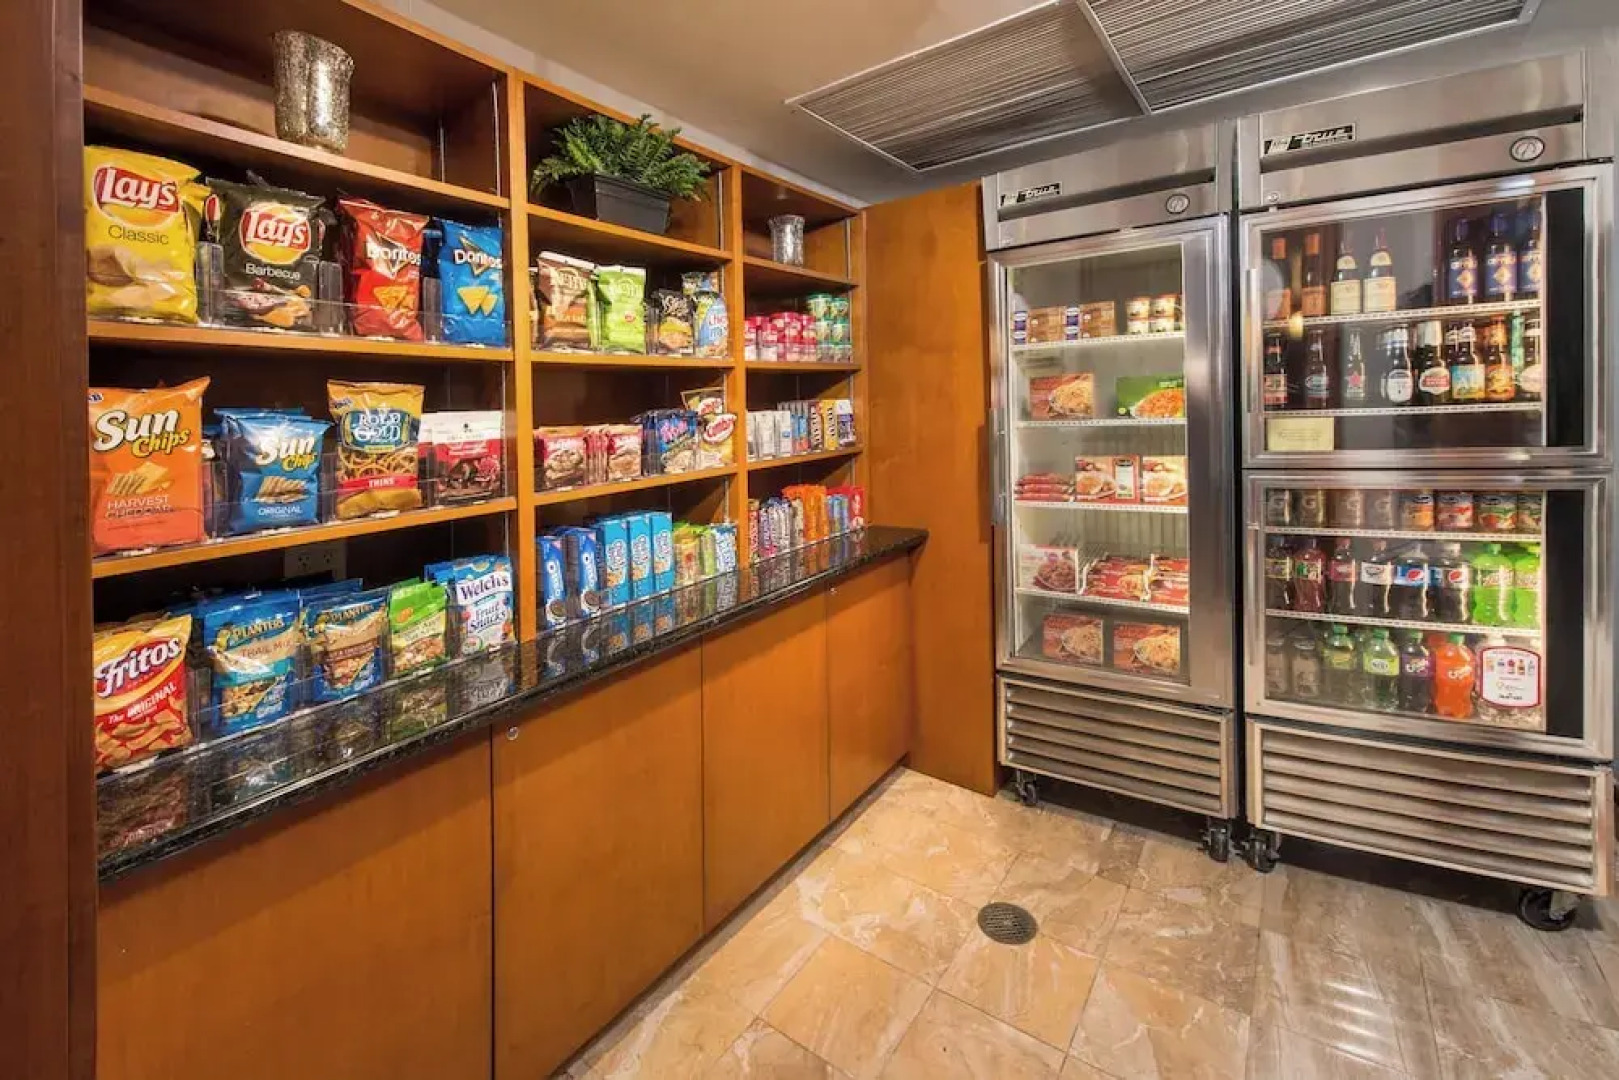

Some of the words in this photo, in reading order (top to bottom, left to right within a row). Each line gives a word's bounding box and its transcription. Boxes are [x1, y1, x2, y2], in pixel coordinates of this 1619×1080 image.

[99, 167, 178, 210] Lay's
[108, 224, 169, 245] Classic
[244, 208, 308, 248] Lay's
[366, 240, 421, 266] Doritos
[454, 247, 502, 269] Doritos
[245, 262, 301, 281] Barbecue
[93, 409, 180, 452] Sun
[131, 428, 191, 458] Chips
[255, 435, 315, 466] Sun
[282, 452, 316, 471] Chip
[368, 477, 395, 488] THINS
[107, 494, 169, 509] HARVEST
[258, 505, 303, 517] ORIGINAL
[460, 573, 509, 601] Welch's
[232, 618, 286, 641] PLANTERS
[469, 610, 506, 633] Snacks
[94, 637, 182, 698] Fritos
[127, 681, 178, 719] ORIGINAL
